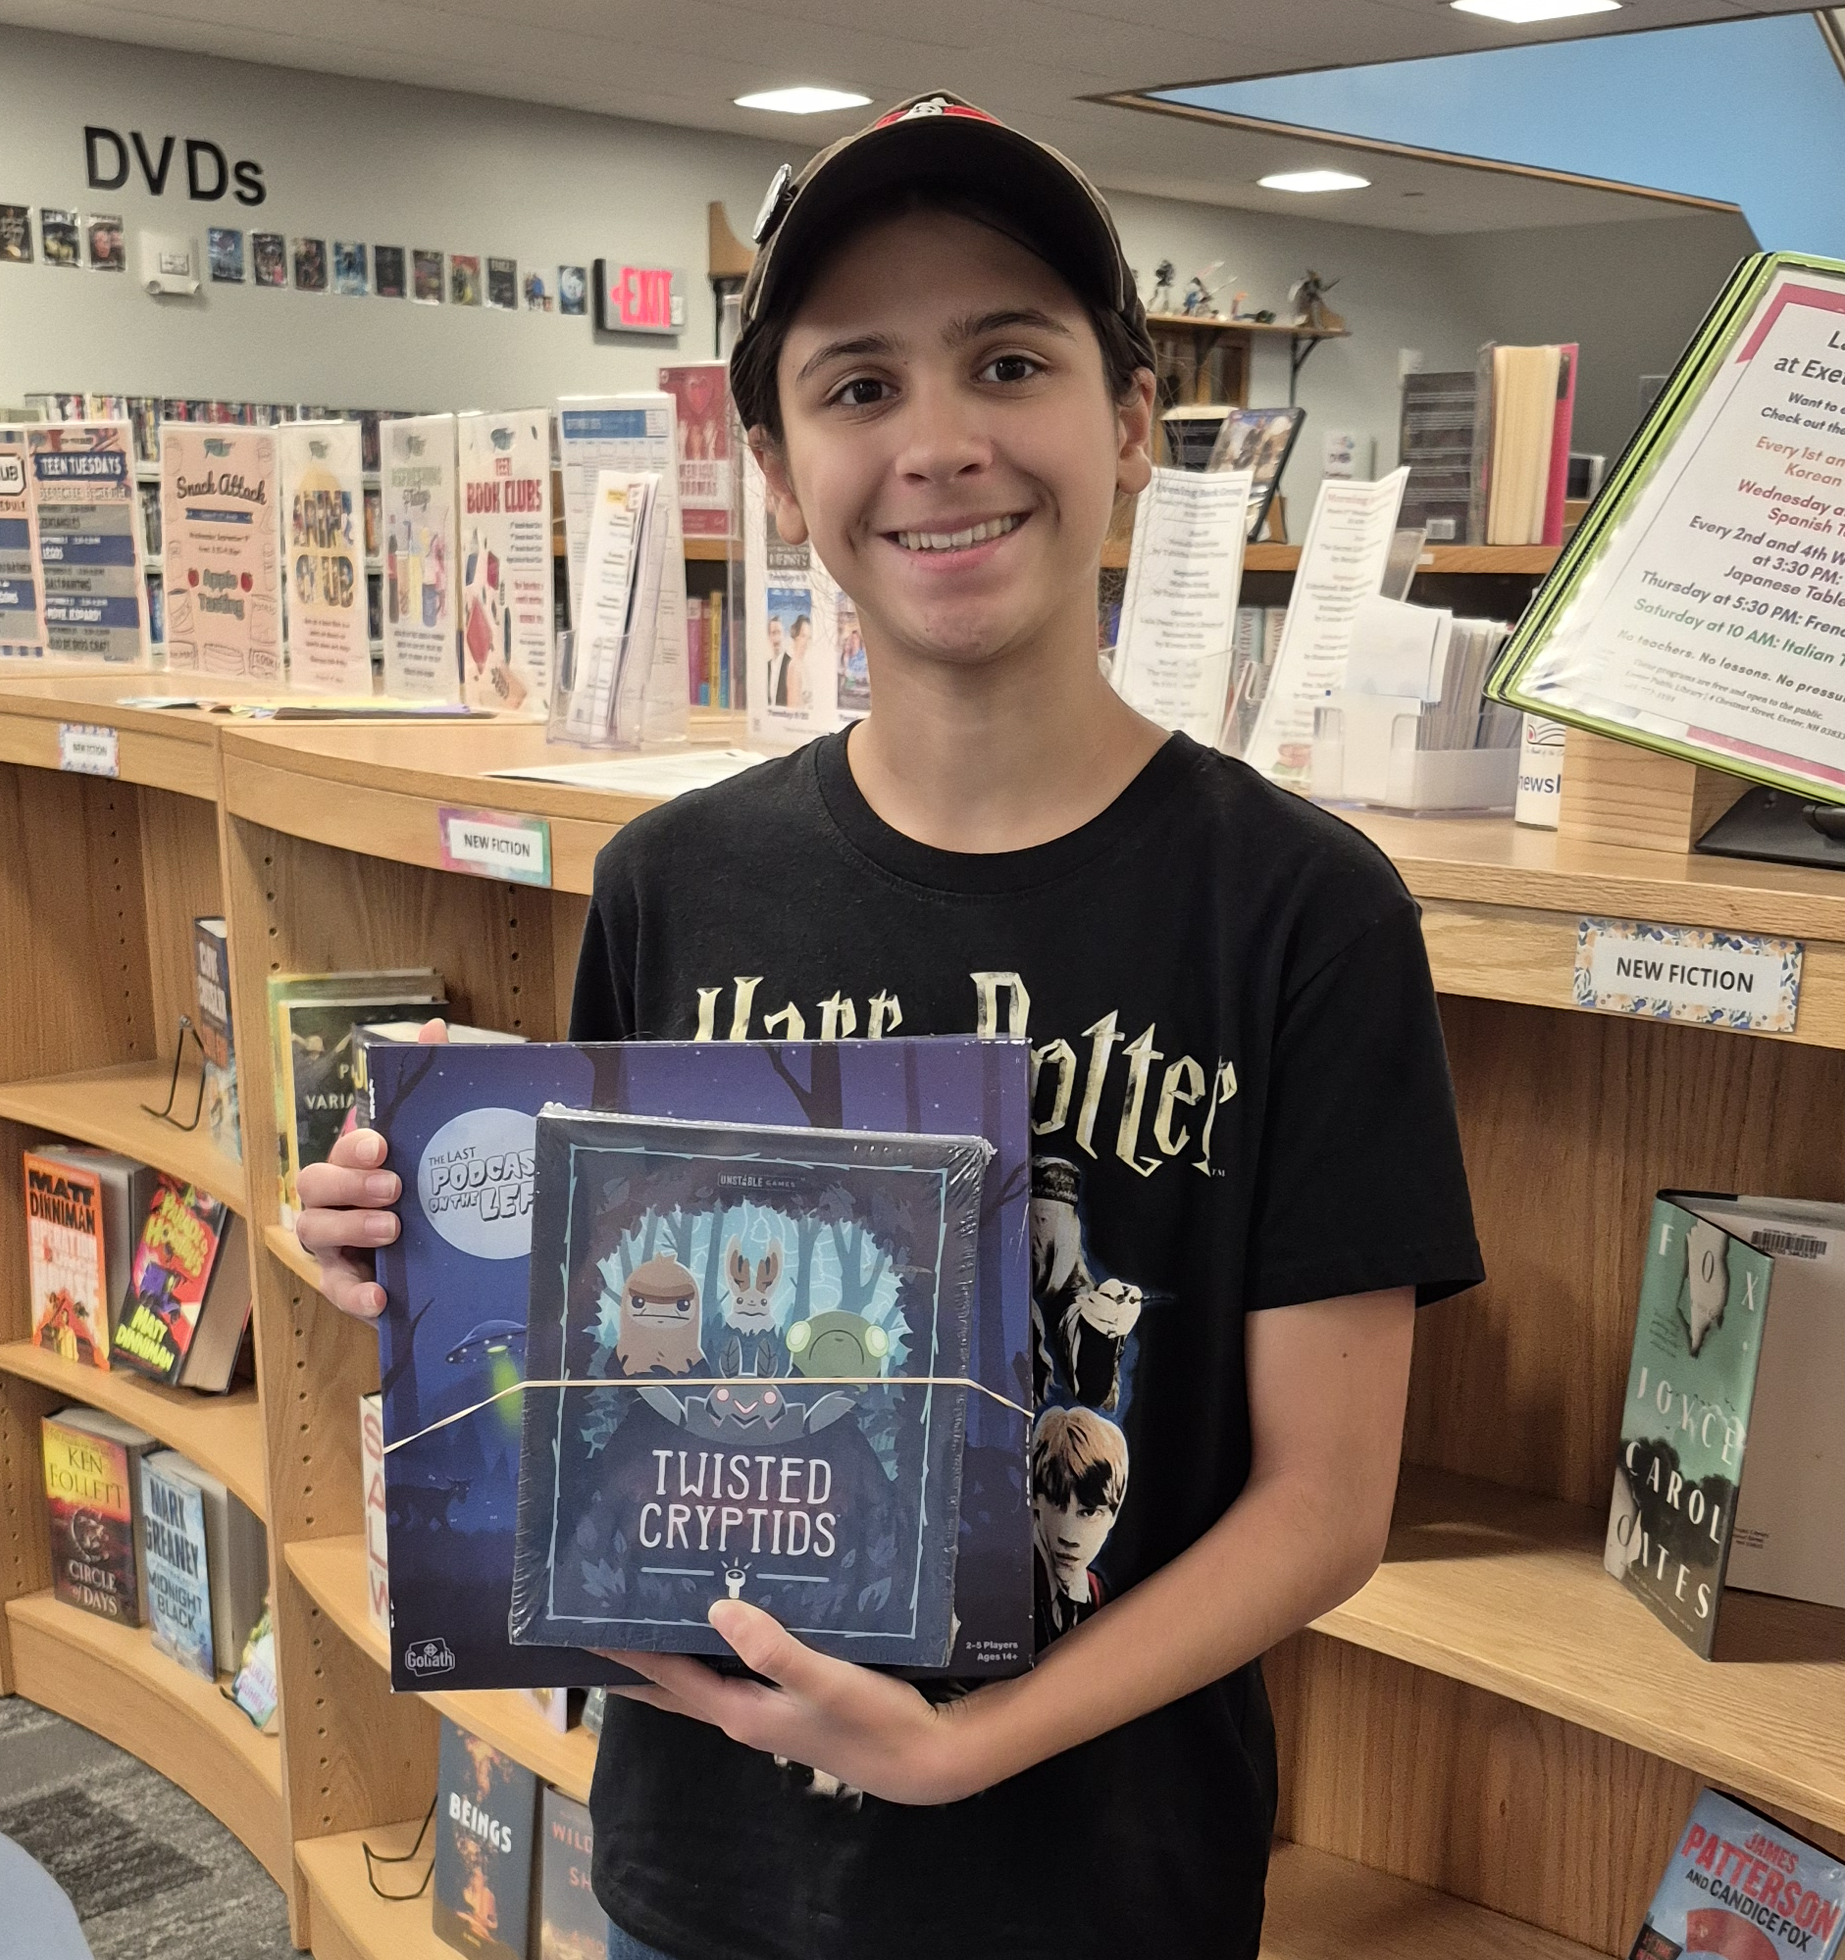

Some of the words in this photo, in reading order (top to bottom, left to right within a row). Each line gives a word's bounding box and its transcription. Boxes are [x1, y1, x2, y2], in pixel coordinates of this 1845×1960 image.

[84, 126, 266, 206] DVDs
[620, 267, 672, 328] EXIT
[1773, 357, 1800, 374] at
[1801, 359, 1845, 385] Exe
[1761, 406, 1802, 425] Check
[1803, 418, 1826, 430] out
[1788, 391, 1823, 409] Want
[1824, 401, 1838, 412] to
[40, 456, 69, 475] TEEN
[68, 455, 122, 476] TUESDAYS
[1756, 436, 1800, 459] Every
[1801, 447, 1823, 462] 1st
[177, 470, 217, 499] Snack
[219, 473, 267, 506] Attack
[1784, 462, 1843, 487] Korean
[466, 481, 501, 514] BOOK
[504, 479, 543, 513] CLUBS
[1737, 478, 1831, 516] Wednesday
[1833, 505, 1845, 518] a
[1689, 515, 1732, 540] Every
[1732, 527, 1767, 545] 2nd
[1766, 540, 1801, 554] and
[1800, 545, 1828, 561] 4th
[1767, 507, 1833, 534] Spanish
[1723, 565, 1802, 595] Japanese
[1752, 555, 1771, 567] at
[1772, 557, 1810, 576] 3:30
[1809, 566, 1843, 585] PM:
[1641, 570, 1711, 604] Thursday
[1712, 594, 1733, 606] at
[1732, 596, 1769, 616] 5:30
[1770, 606, 1803, 626] PM:
[1633, 598, 1705, 631] Saturday
[1706, 621, 1726, 633] at
[1726, 623, 1744, 638] 10
[1745, 630, 1781, 649] AM:
[1781, 639, 1835, 664] Italian
[1617, 629, 1634, 642] No
[1637, 635, 1695, 660] teachers.
[1699, 652, 1716, 665] No
[1719, 657, 1772, 681] lessons.
[1775, 673, 1793, 687] No
[1795, 682, 1845, 703] pressu
[1656, 664, 1695, 684] programs
[1697, 678, 1710, 686] are
[1711, 681, 1729, 692] free
[1729, 686, 1747, 697] and
[1747, 692, 1767, 706] open
[1769, 697, 1778, 706] to
[1779, 700, 1794, 711] the
[1794, 705, 1824, 720] public.
[1675, 683, 1703, 699] Library
[1715, 695, 1750, 713] Chestnut
[1807, 722, 1820, 733] NH
[464, 834, 490, 849] NEW
[491, 838, 530, 857] FICTION
[1615, 957, 1664, 981] NEW
[1668, 964, 1754, 993] FICTION
[429, 1157, 445, 1167] THE
[448, 1146, 476, 1163] LAST
[28, 1169, 95, 1206] MATT
[429, 1197, 449, 1213] ON
[450, 1191, 479, 1210] THE
[30, 1191, 96, 1235] DINNIMAN
[131, 1303, 168, 1343] MATT
[114, 1323, 176, 1373] DINNIMAN
[1636, 1367, 1738, 1466] JOYCE
[68, 1446, 103, 1475] KEN
[652, 1449, 832, 1505] TWISTED
[50, 1463, 124, 1510] FOLLETT
[150, 1478, 187, 1534] MARK
[1625, 1441, 1722, 1545] CAROL
[144, 1514, 199, 1580] GREANEY
[639, 1502, 837, 1557] CRYPTIDS
[68, 1559, 117, 1594] CIRCLE
[147, 1567, 203, 1615] MIDNIGHT
[83, 1586, 118, 1617] DAYS
[158, 1597, 197, 1634] BLACK
[407, 1650, 453, 1668] Goliath
[965, 1641, 982, 1650] 2-5
[983, 1641, 1019, 1650] Players
[977, 1653, 1000, 1662] Ages
[449, 1792, 512, 1853] BEINGS
[1744, 1832, 1799, 1875] JAMES
[1680, 1823, 1842, 1943] PATTERSON
[1685, 1869, 1709, 1891] AND
[1709, 1879, 1780, 1933] CANDICE
[1777, 1920, 1813, 1953] FOX
